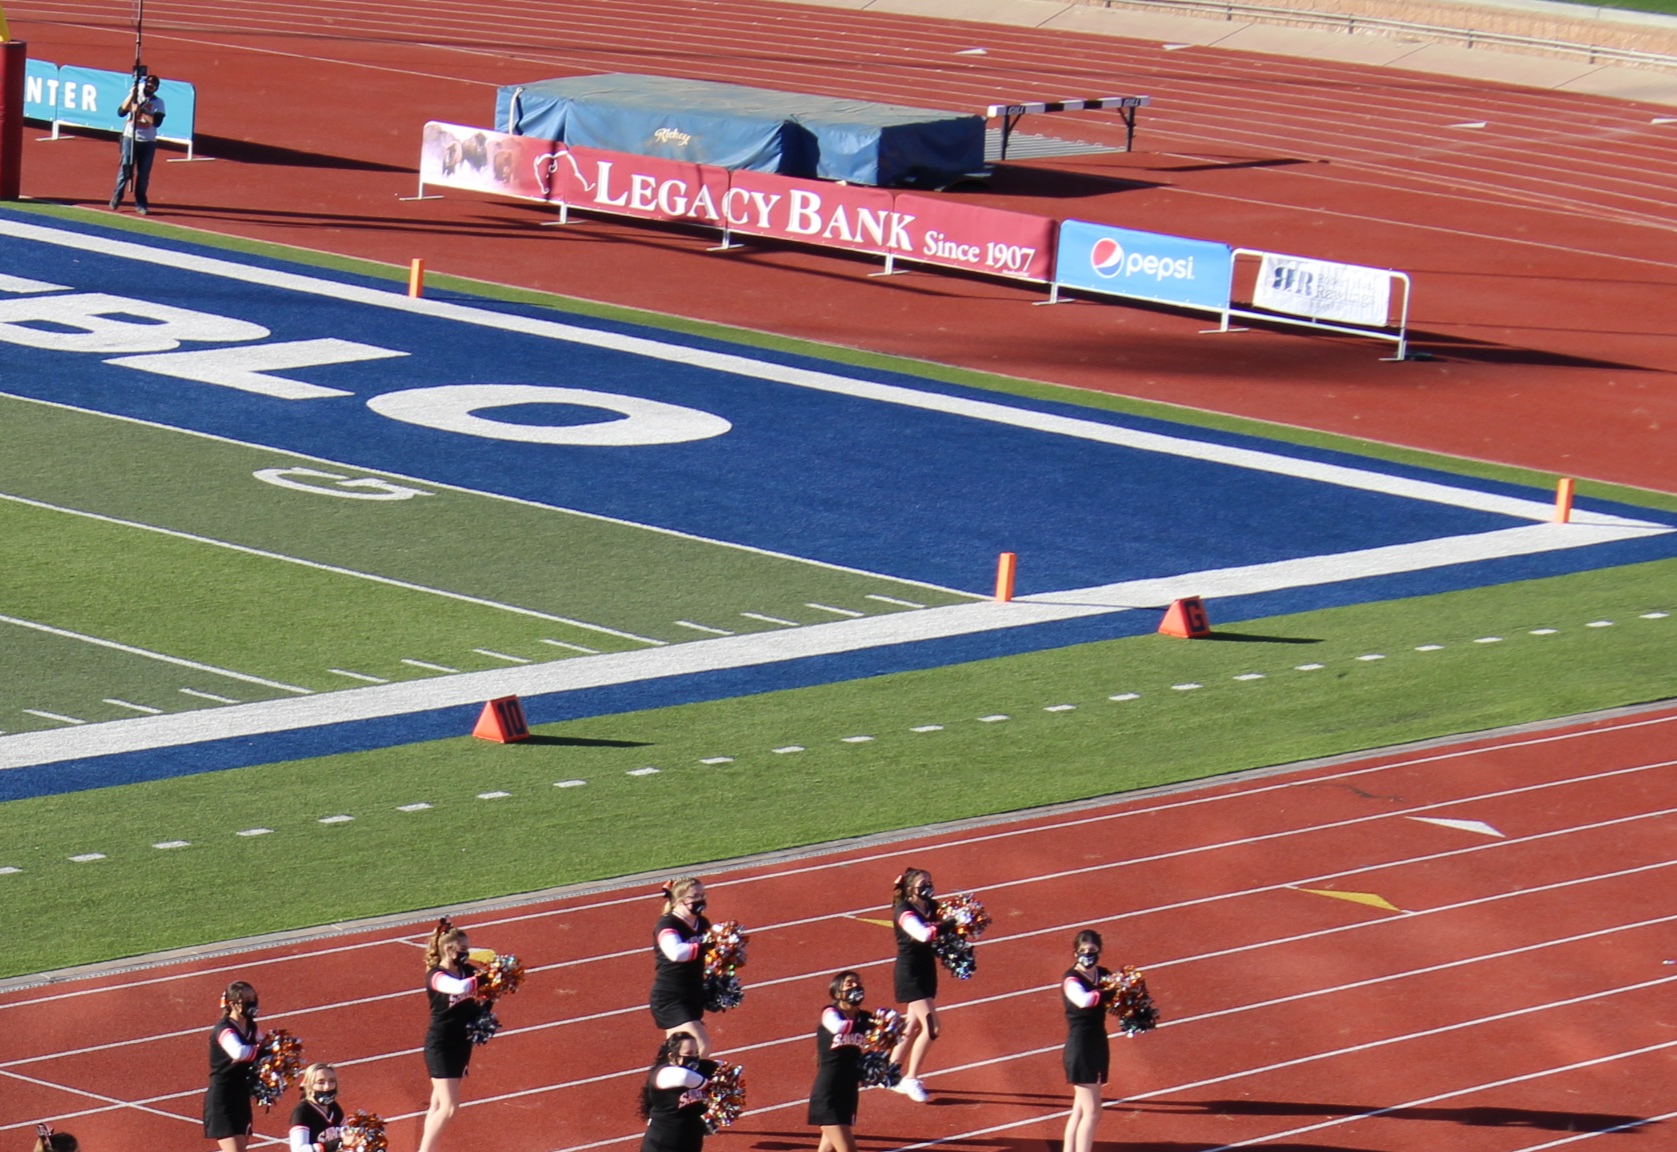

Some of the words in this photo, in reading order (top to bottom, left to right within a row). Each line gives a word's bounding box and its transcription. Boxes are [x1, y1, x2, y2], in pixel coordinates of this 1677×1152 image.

[25, 78, 98, 113] NTER
[595, 160, 782, 230] LEGACY
[786, 188, 916, 253] BANK
[923, 230, 980, 263] Since
[984, 241, 1036, 275] 1907
[1125, 253, 1194, 281] pepsi
[252, 466, 436, 501] G
[1184, 600, 1206, 633] G
[497, 700, 527, 738] 10
